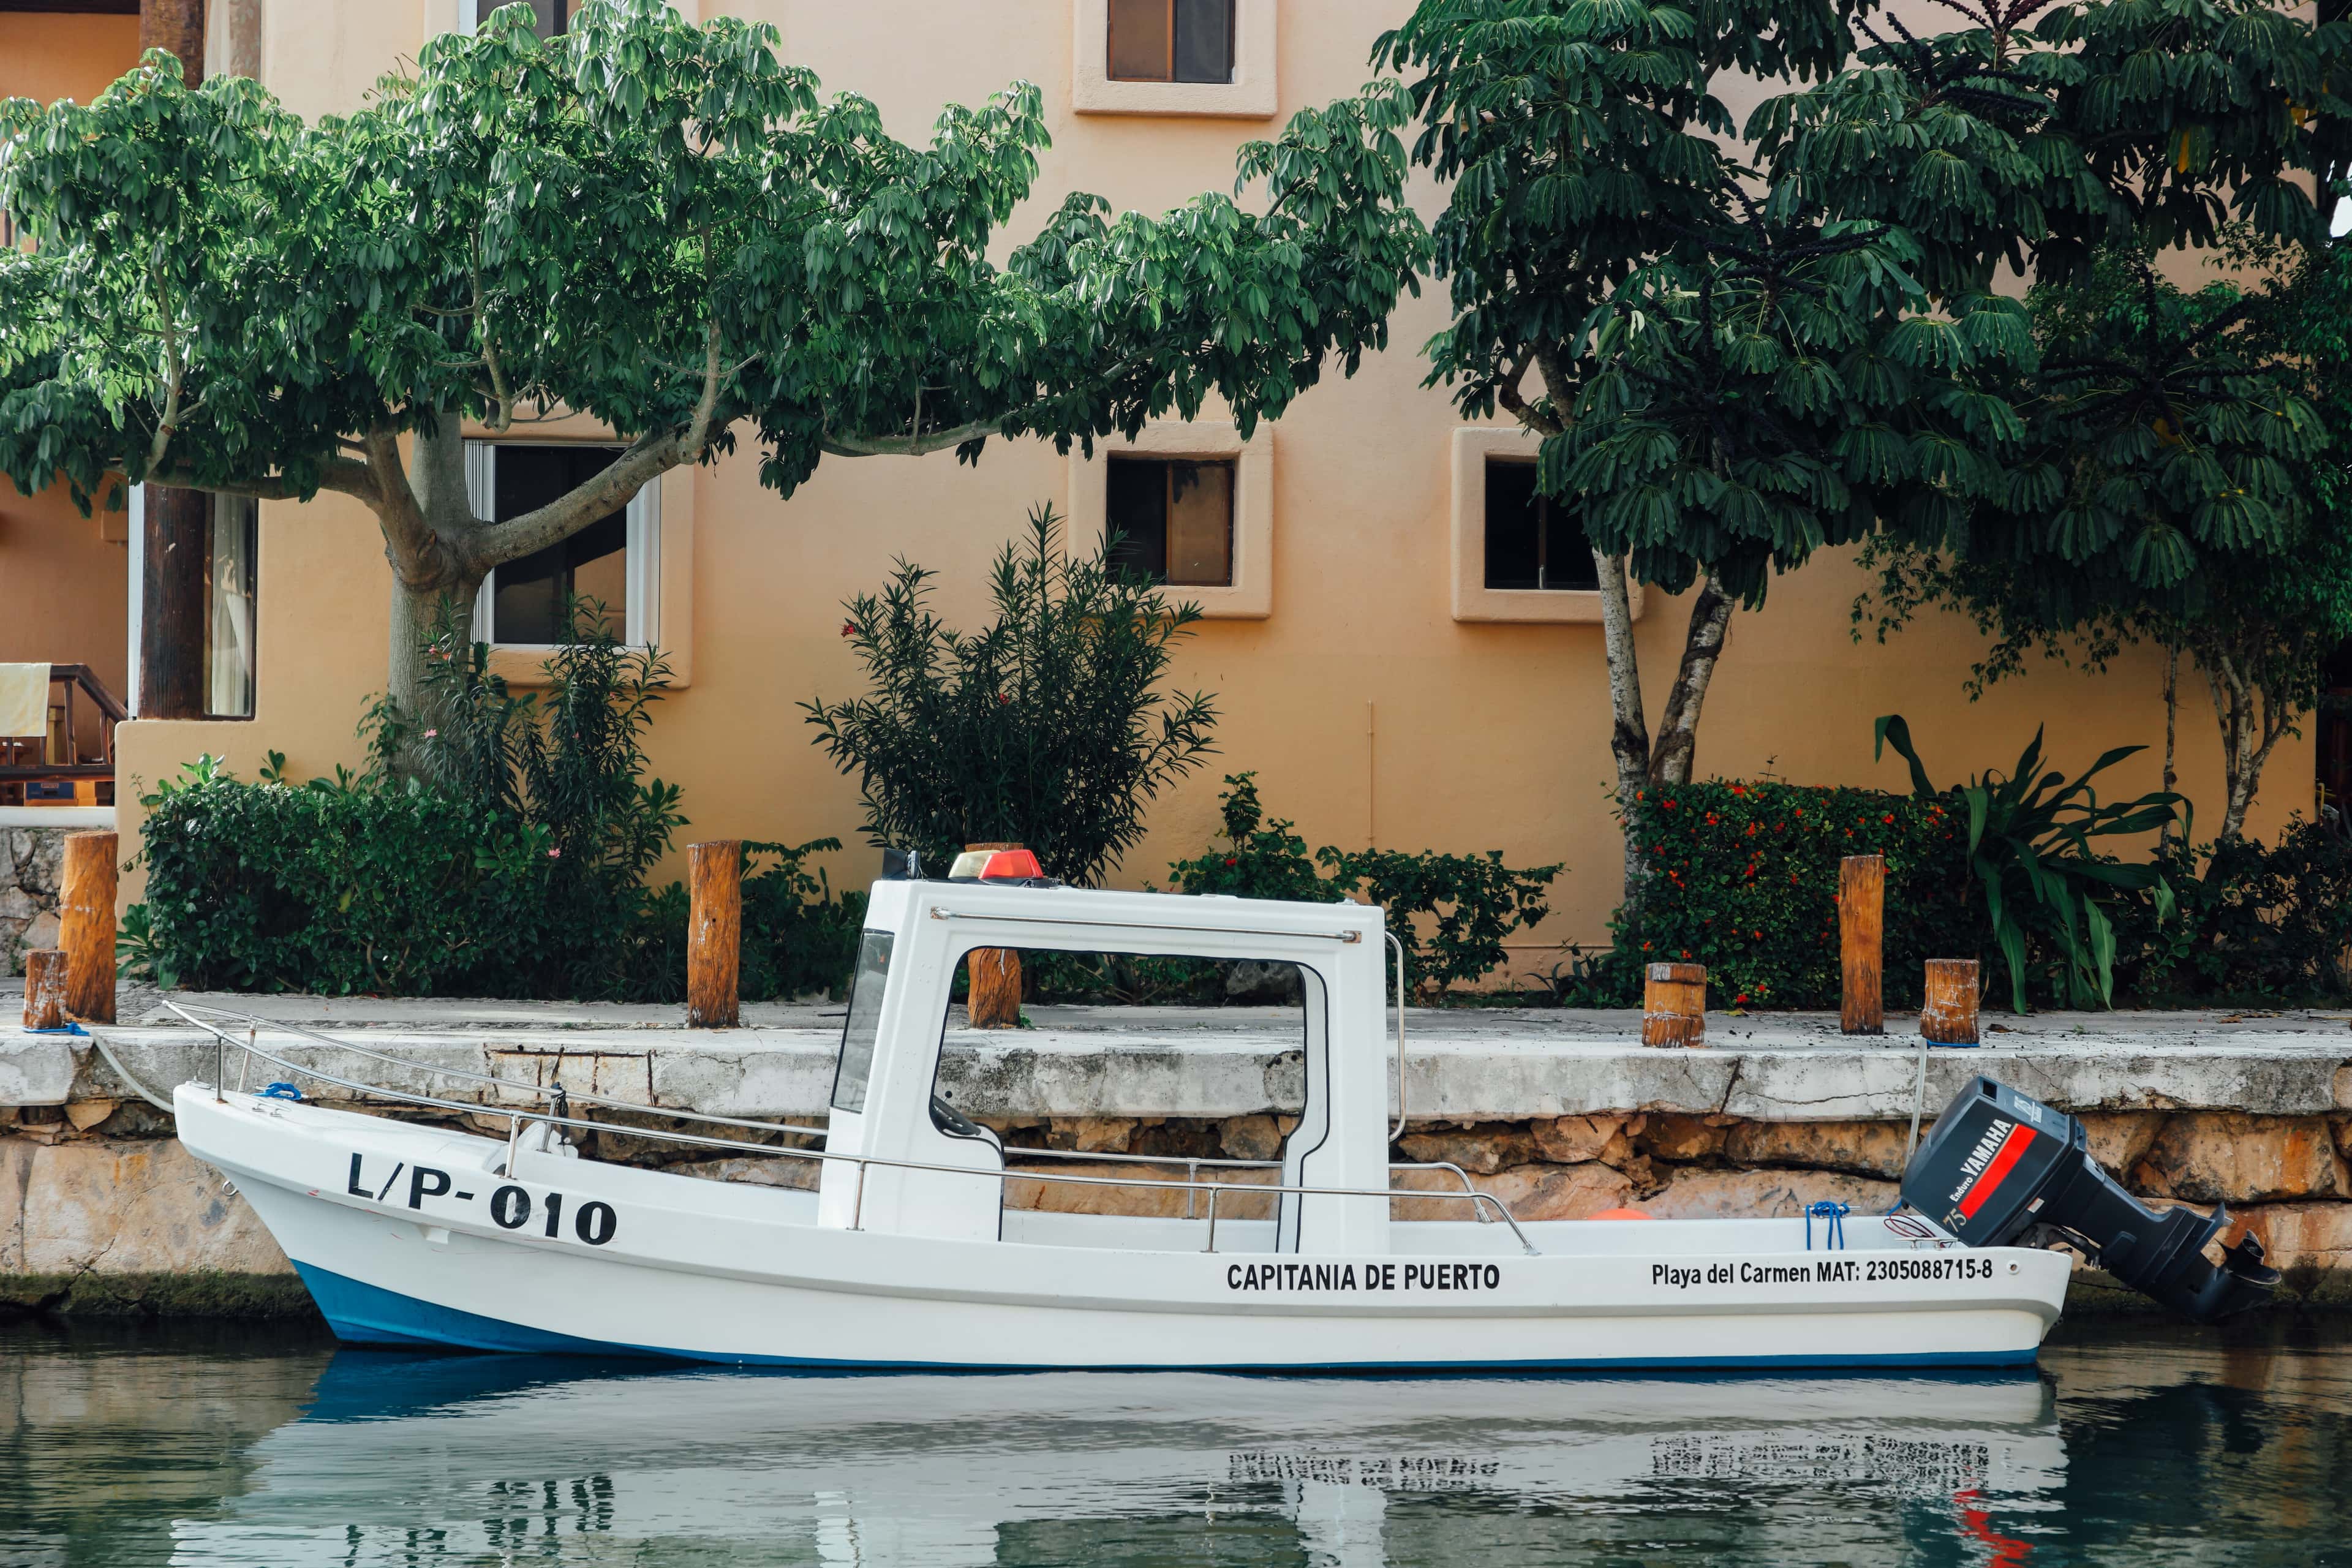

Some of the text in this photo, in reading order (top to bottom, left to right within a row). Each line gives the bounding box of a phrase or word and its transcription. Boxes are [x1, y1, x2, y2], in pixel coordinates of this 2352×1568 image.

[1949, 1118, 2012, 1202] Enduro YAMAHA
[348, 1152, 617, 1246] L/P-010
[1943, 1208, 1967, 1233] 75
[1227, 1264, 1501, 1291] CAPITANIA DE PUERTO
[1653, 1259, 1993, 1289] Playa del Carmen MAT: 2305088715-8
